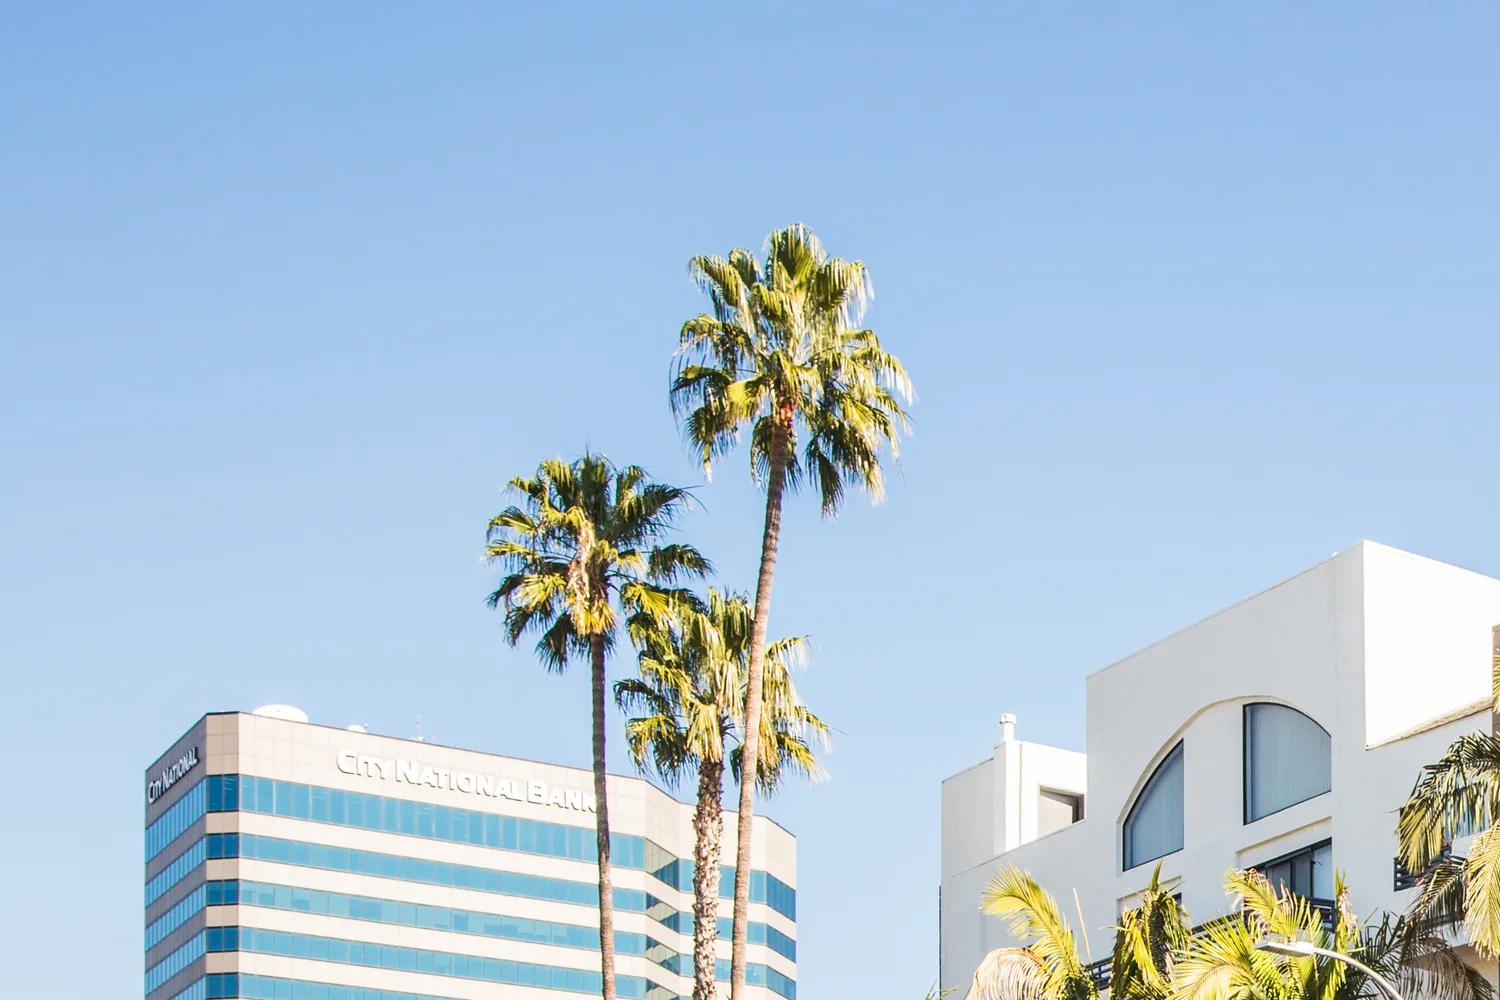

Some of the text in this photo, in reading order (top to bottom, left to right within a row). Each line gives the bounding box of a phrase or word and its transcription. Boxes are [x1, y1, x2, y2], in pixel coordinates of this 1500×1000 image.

[148, 747, 198, 804] CITY NATIONAL
[336, 750, 389, 780] CITY
[395, 758, 522, 802] NATIONAL
